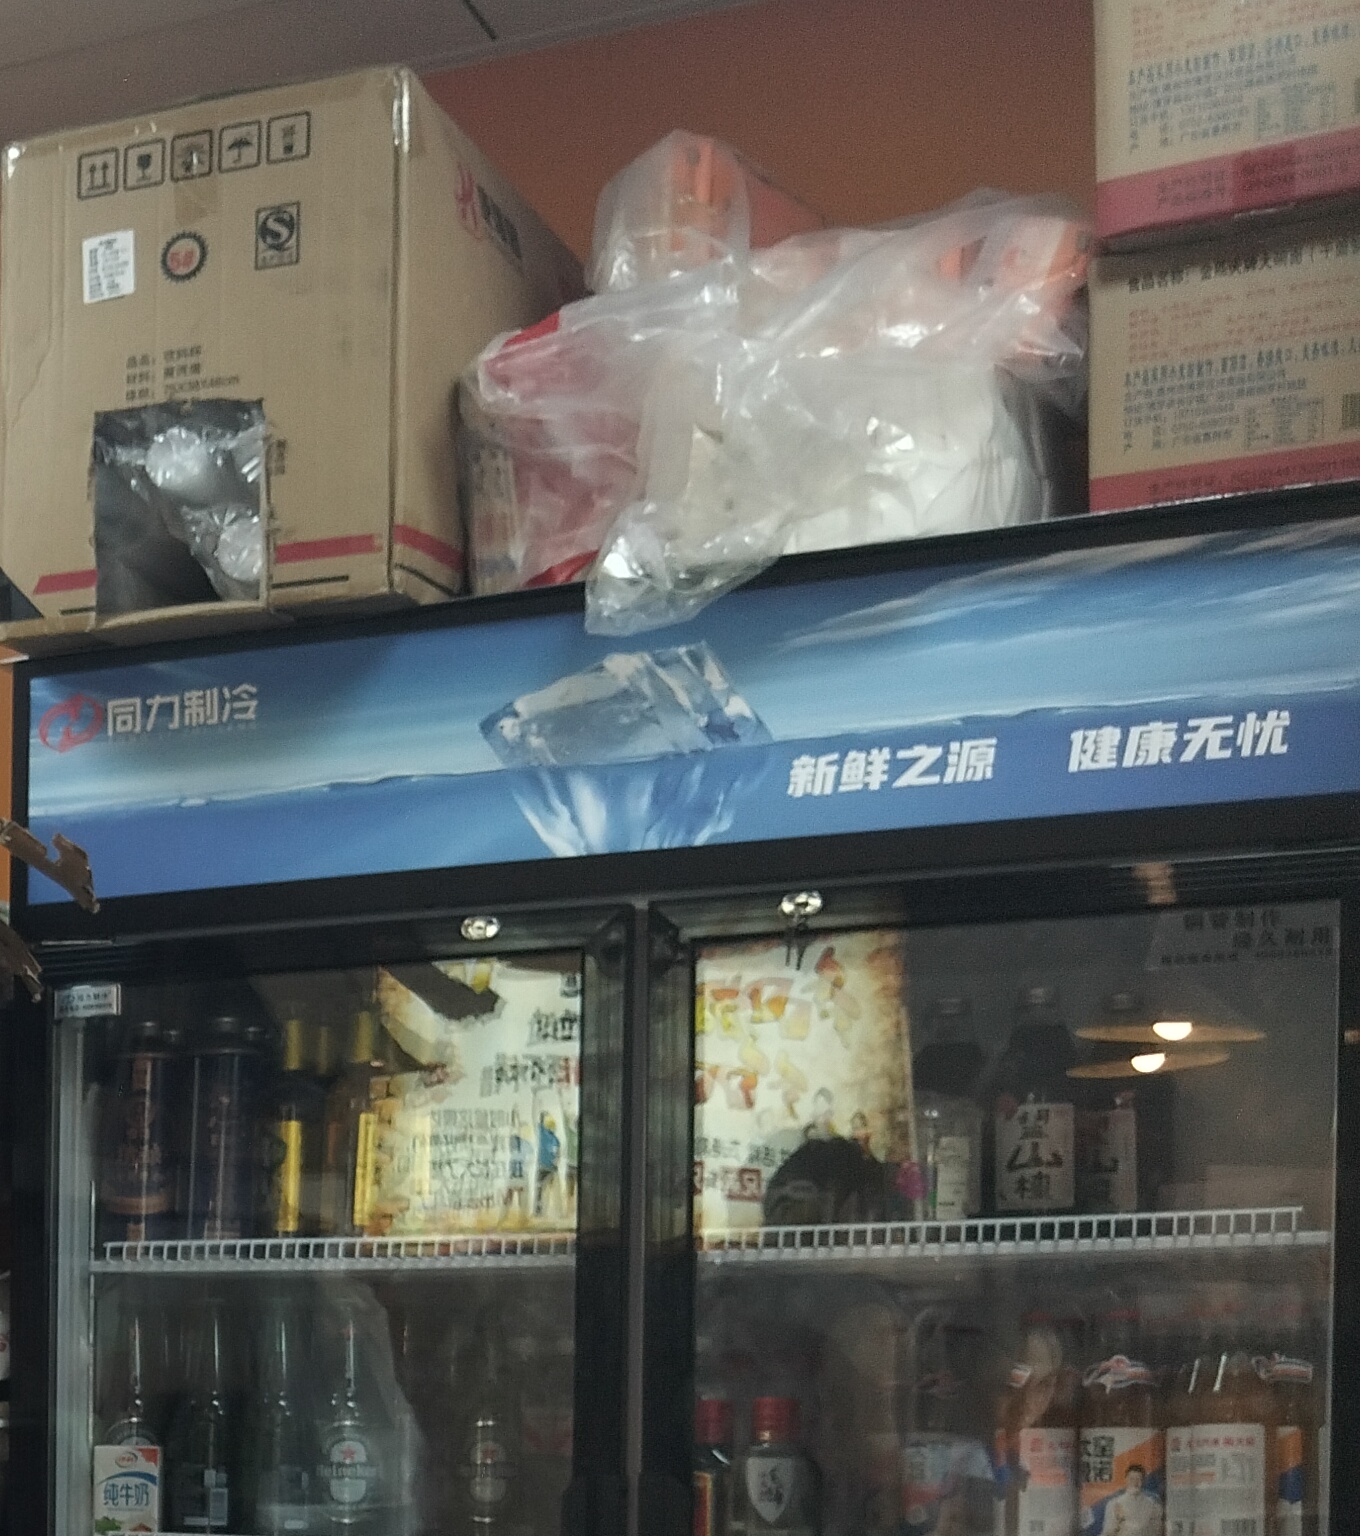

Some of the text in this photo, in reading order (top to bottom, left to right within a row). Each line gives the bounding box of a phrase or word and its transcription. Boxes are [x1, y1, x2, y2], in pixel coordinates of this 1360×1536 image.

[108, 683, 258, 737] 同力制冷
[787, 710, 1292, 798] 新鲜之源 健康无忧
[103, 1482, 150, 1507] 纯牛奶
